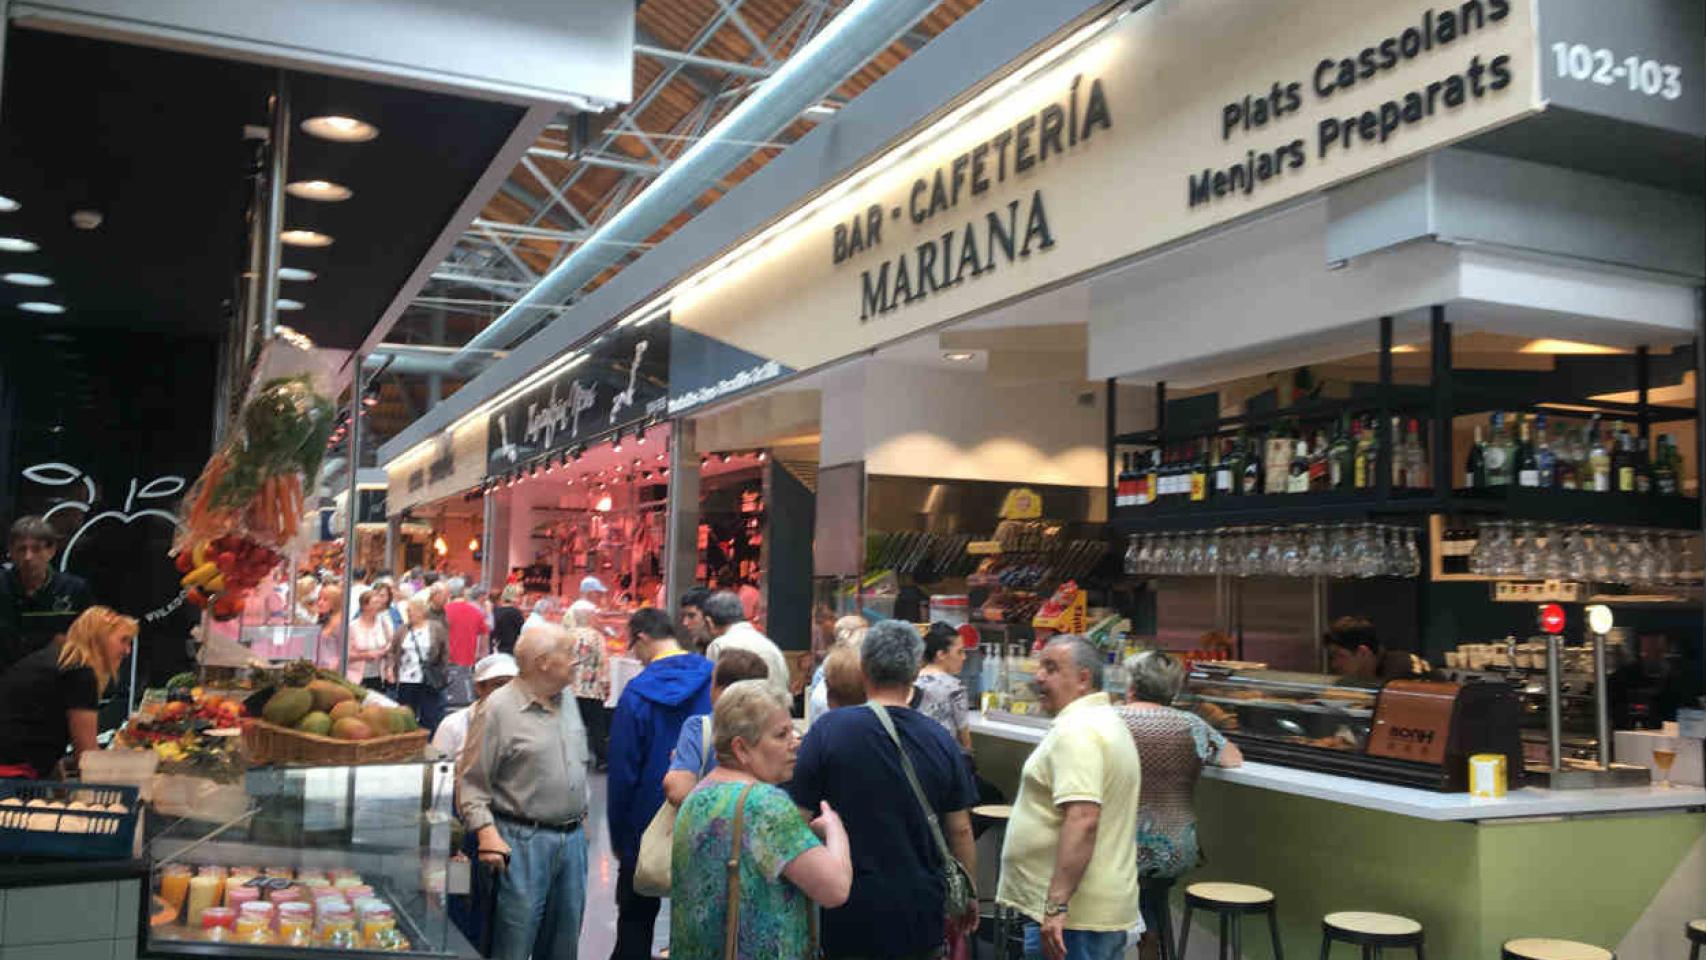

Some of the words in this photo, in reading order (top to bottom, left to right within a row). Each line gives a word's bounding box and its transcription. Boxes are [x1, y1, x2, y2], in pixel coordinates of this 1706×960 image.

[1188, 136, 1305, 207] Menjars
[1317, 52, 1513, 158] Preparats
[1222, 80, 1302, 140] Plats
[1313, 0, 1510, 97] Cassolans
[1551, 41, 1683, 100] 102-103
[833, 204, 883, 264] BAR
[909, 74, 1111, 225] CAFETERÍA
[859, 189, 1056, 322] MARIANA
